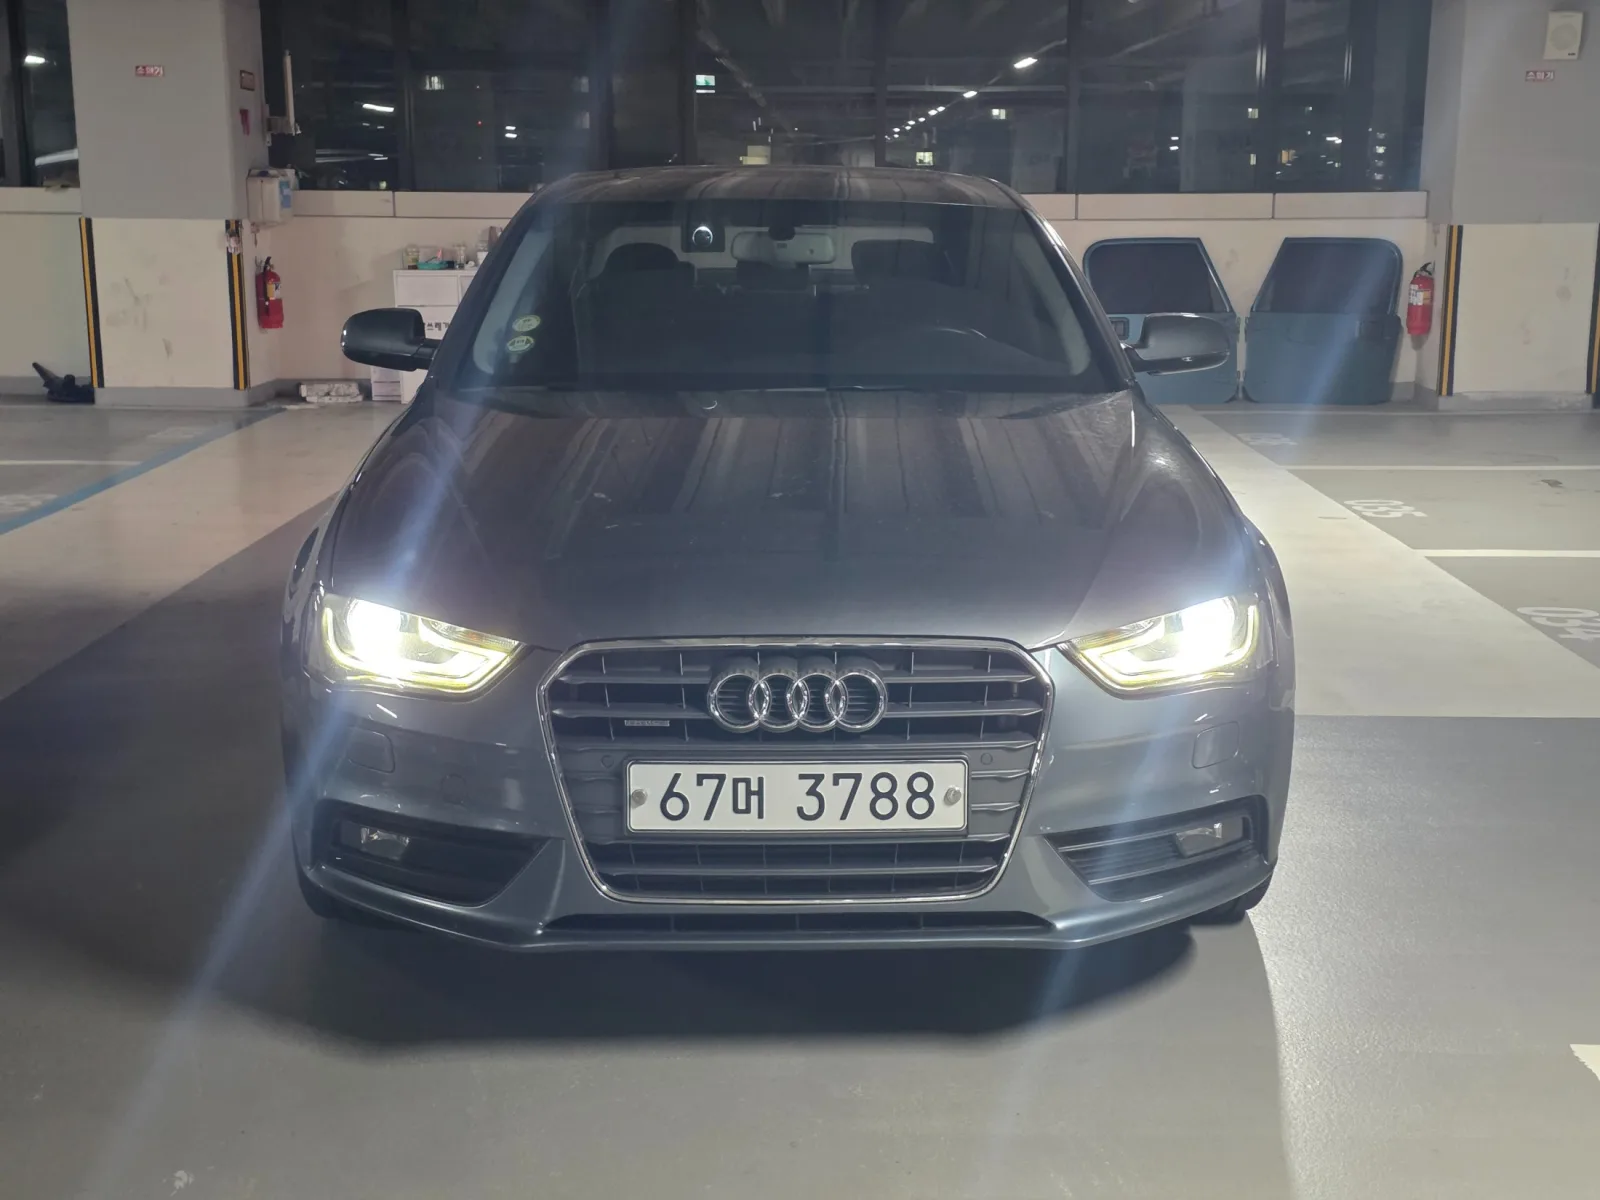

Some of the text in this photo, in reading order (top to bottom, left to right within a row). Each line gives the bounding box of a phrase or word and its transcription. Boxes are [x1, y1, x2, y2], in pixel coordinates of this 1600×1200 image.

[1344, 499, 1428, 518] 035
[659, 772, 935, 821] 67머 3788
